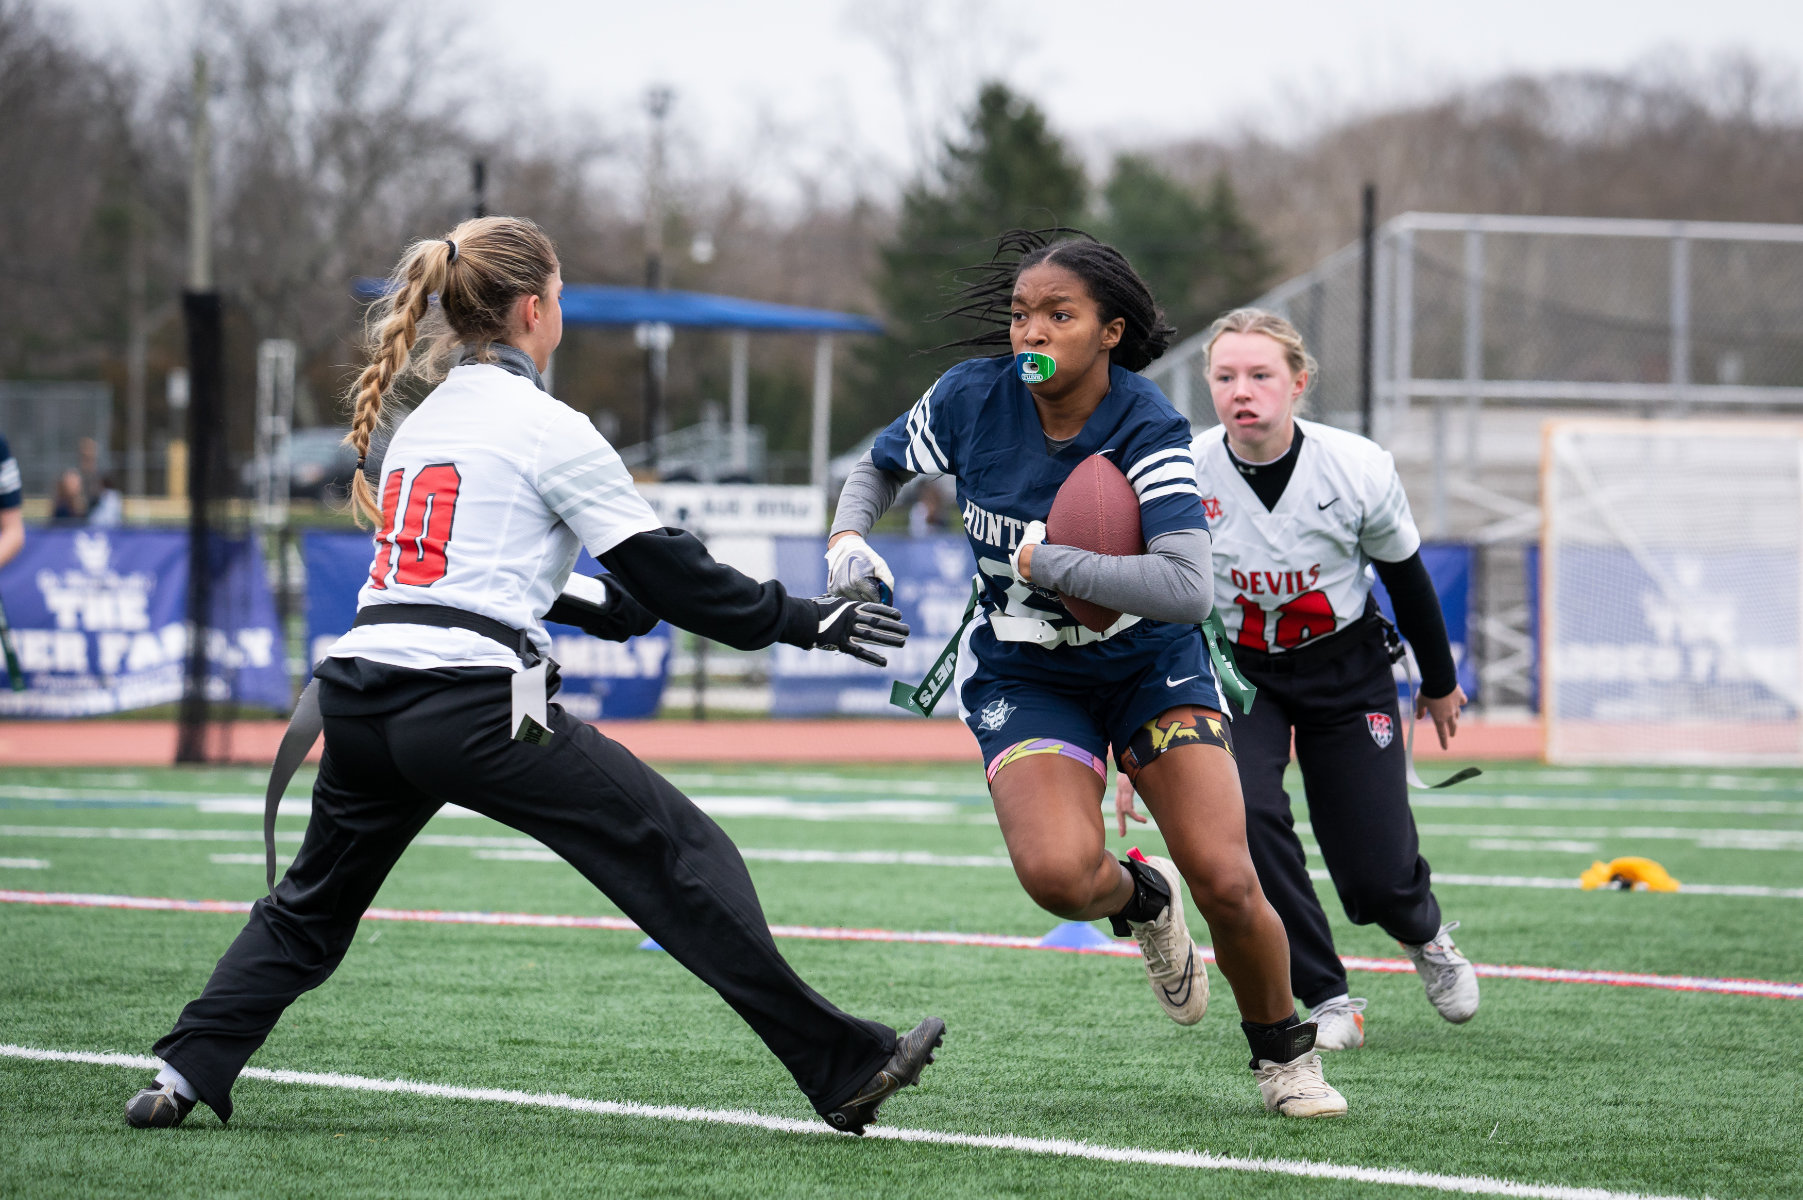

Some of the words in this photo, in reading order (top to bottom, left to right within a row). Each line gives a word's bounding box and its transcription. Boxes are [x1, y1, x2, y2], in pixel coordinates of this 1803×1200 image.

[368, 462, 461, 590] 10
[1231, 563, 1321, 595] DEVILS
[919, 652, 957, 708] JETS
